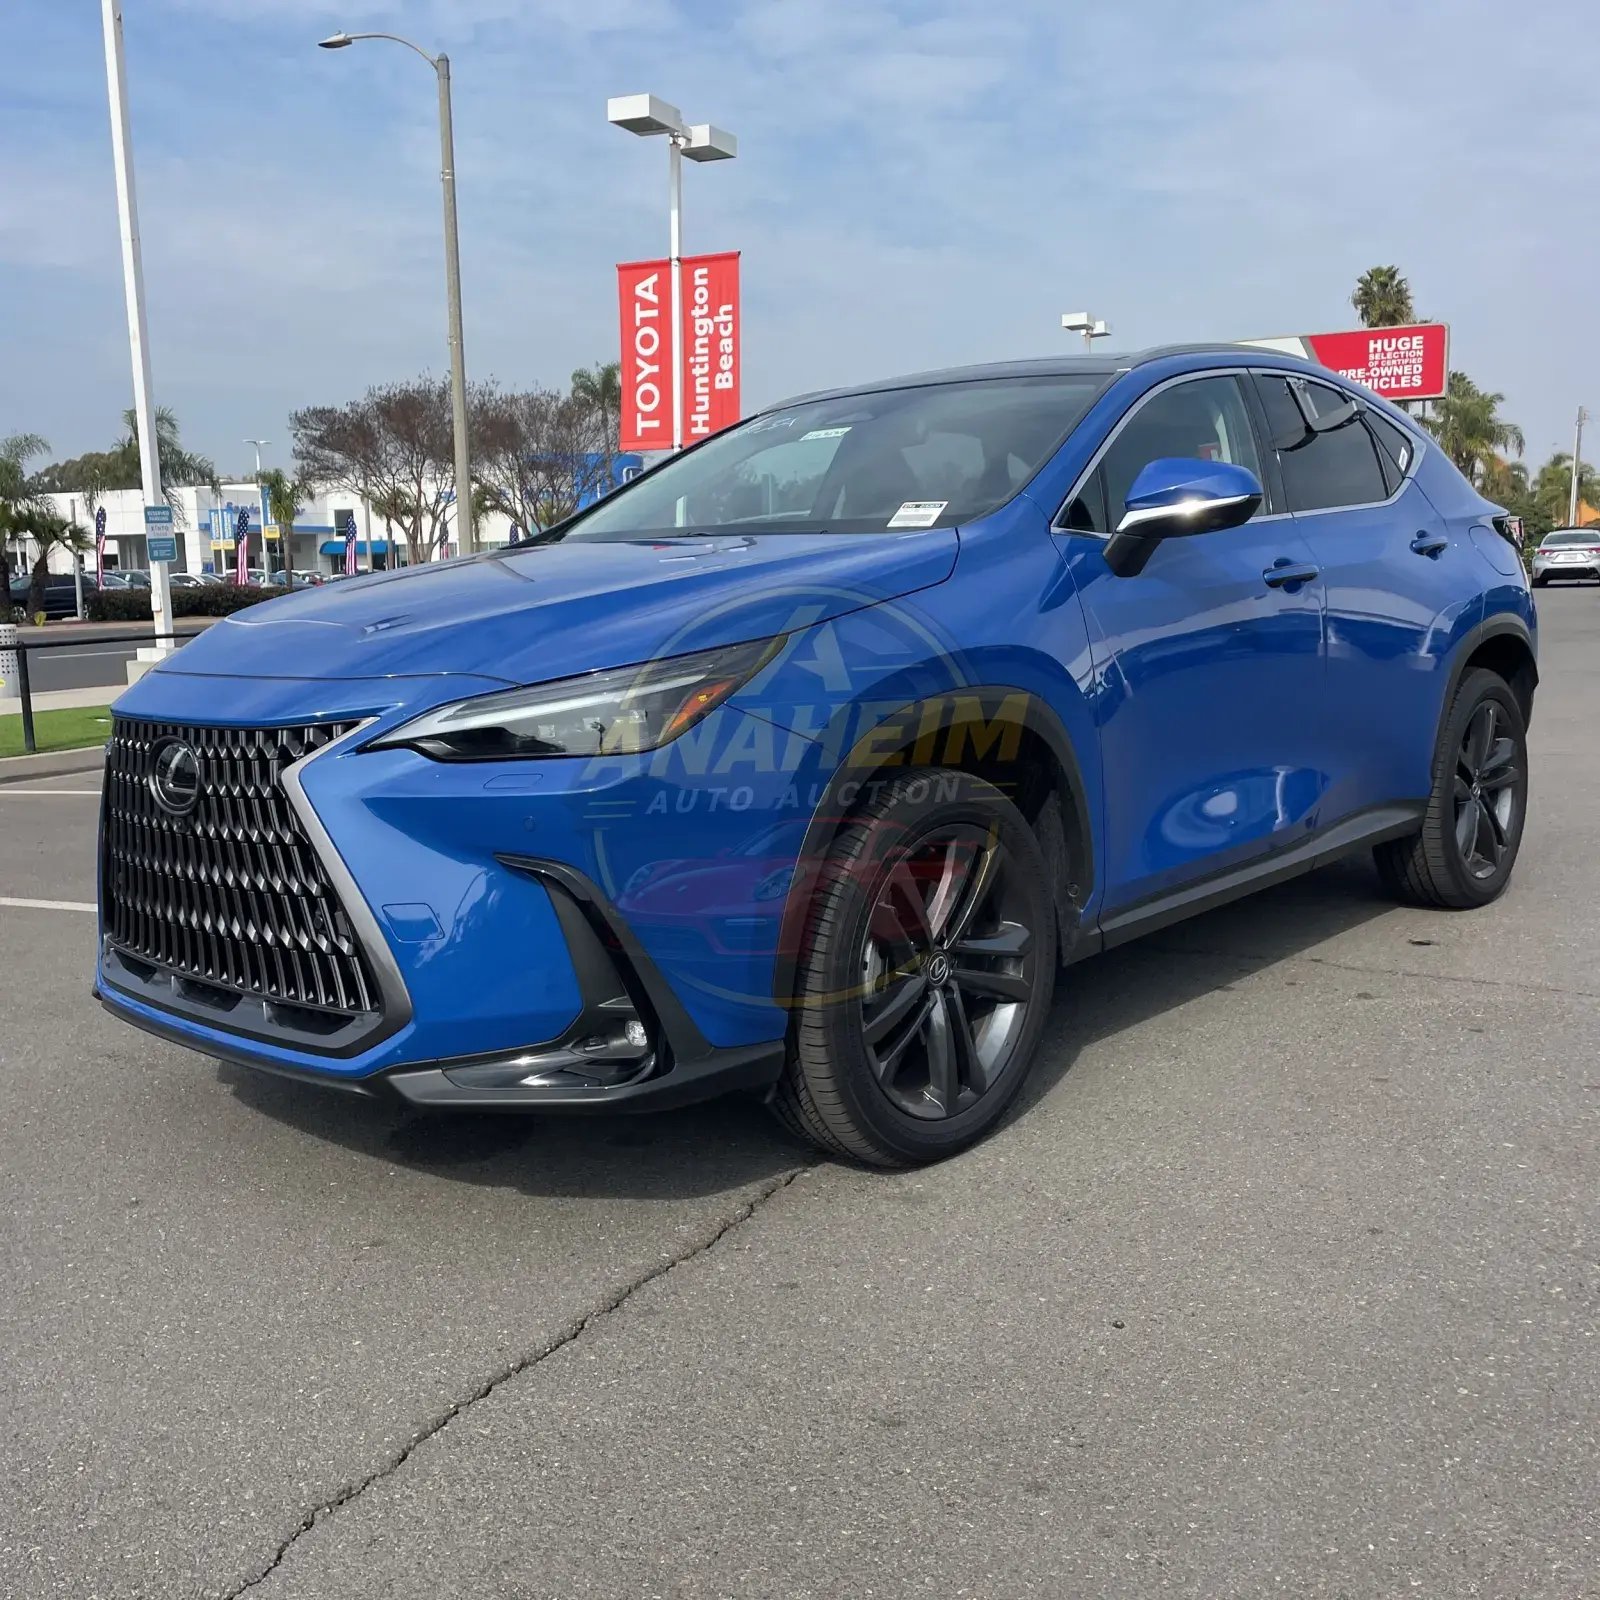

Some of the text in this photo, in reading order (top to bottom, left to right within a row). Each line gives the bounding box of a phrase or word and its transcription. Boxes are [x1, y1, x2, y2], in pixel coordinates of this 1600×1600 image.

[635, 272, 660, 436] TOYOTA
[689, 267, 714, 434] Huntington
[713, 303, 733, 390] Beach
[1368, 335, 1424, 353] HUGE
[1368, 350, 1423, 361] SELECTION
[1368, 357, 1423, 368] OF CERTIFIED
